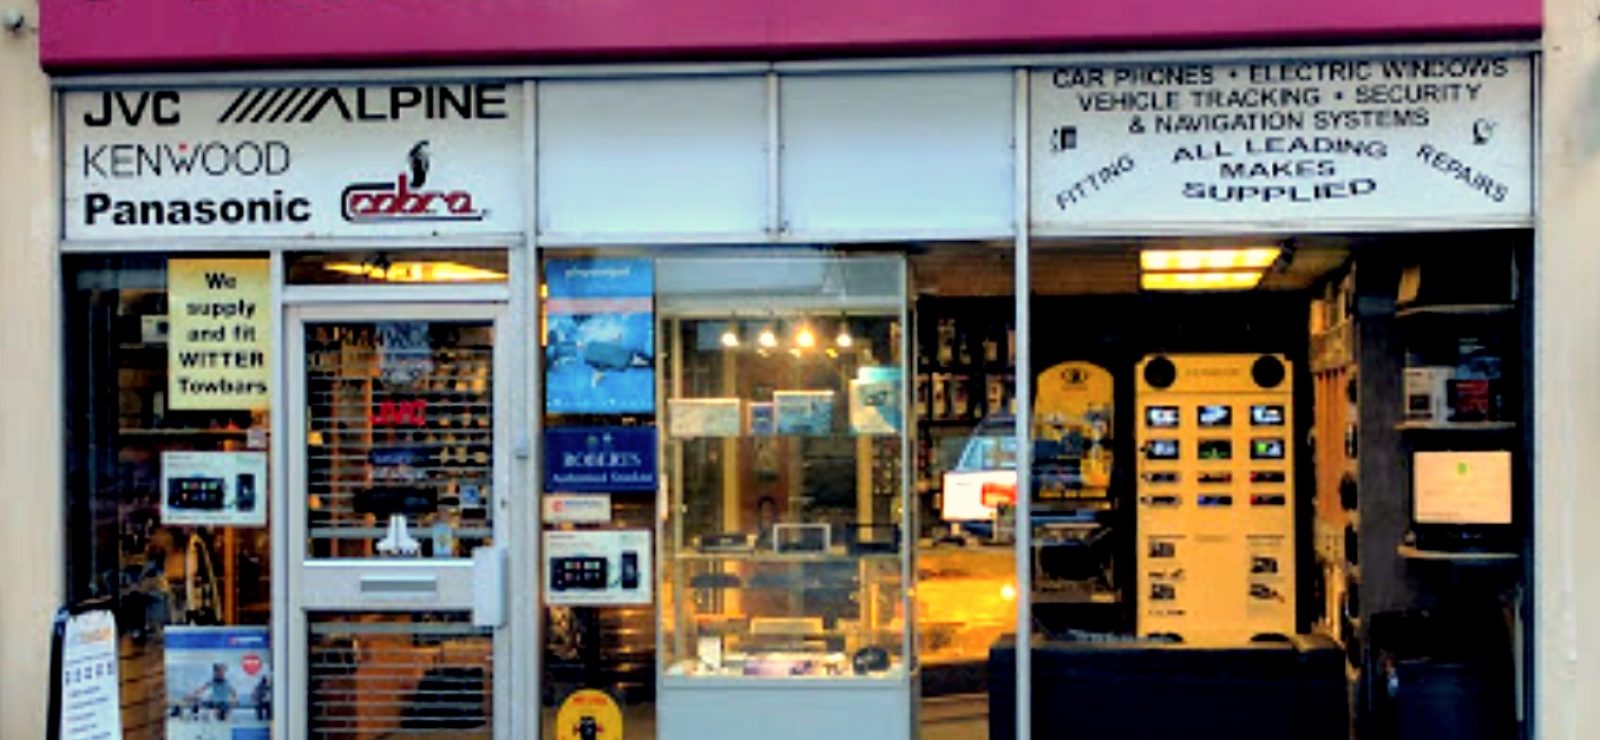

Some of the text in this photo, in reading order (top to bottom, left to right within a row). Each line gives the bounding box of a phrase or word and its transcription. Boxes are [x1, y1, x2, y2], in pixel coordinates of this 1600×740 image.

[1052, 57, 1508, 88] CAR PHONES ELECTRIC WINDOWS
[84, 90, 181, 126] JVC
[300, 84, 508, 122] ALPINE
[1077, 82, 1483, 112] VEHICLE TRACKING SECURITY
[1128, 107, 1430, 134] & NAVIGATION SYSTEMS
[84, 140, 290, 178] KENWOOD
[1172, 136, 1388, 164] ALL LEADING
[1055, 153, 1135, 211] FITTING
[1219, 159, 1335, 179] MAKES
[1416, 142, 1509, 203] REPAIRS
[346, 172, 480, 216] cobra
[1182, 177, 1377, 203] SUPPLIED
[84, 189, 311, 225] Panasonic
[204, 272, 237, 290] We
[186, 299, 256, 319] supply
[187, 325, 256, 342] and fit
[178, 351, 264, 368] WITTER
[178, 377, 267, 394] Towbars
[371, 399, 427, 426] JVC
